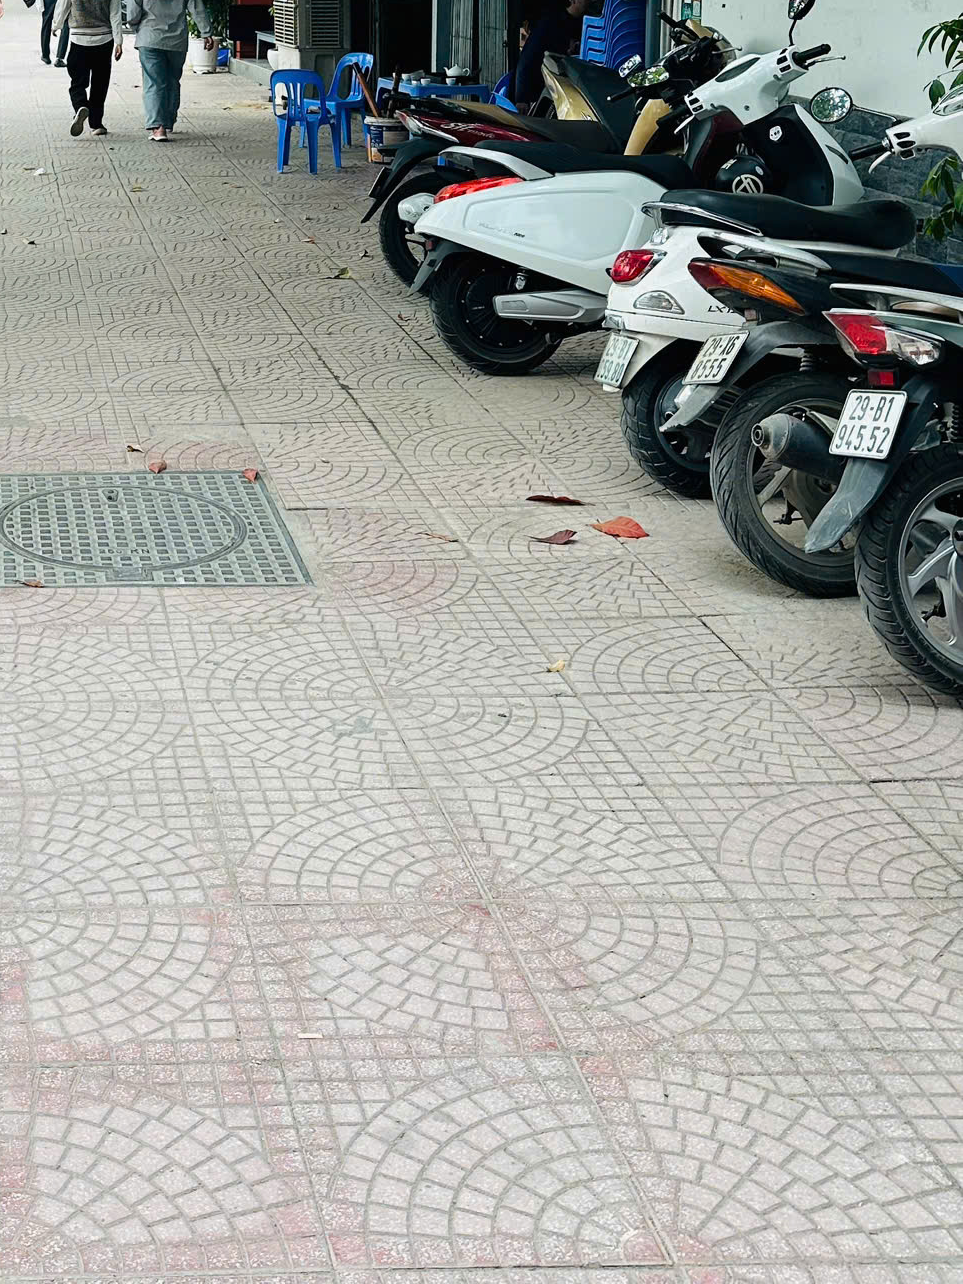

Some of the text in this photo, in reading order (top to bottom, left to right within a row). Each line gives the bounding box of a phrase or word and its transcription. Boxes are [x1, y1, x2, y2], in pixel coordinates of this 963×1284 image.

[703, 335, 740, 357] 29-X6
[690, 357, 727, 380] 8555
[849, 395, 895, 422] 29-B1
[835, 424, 891, 453] 945.52
